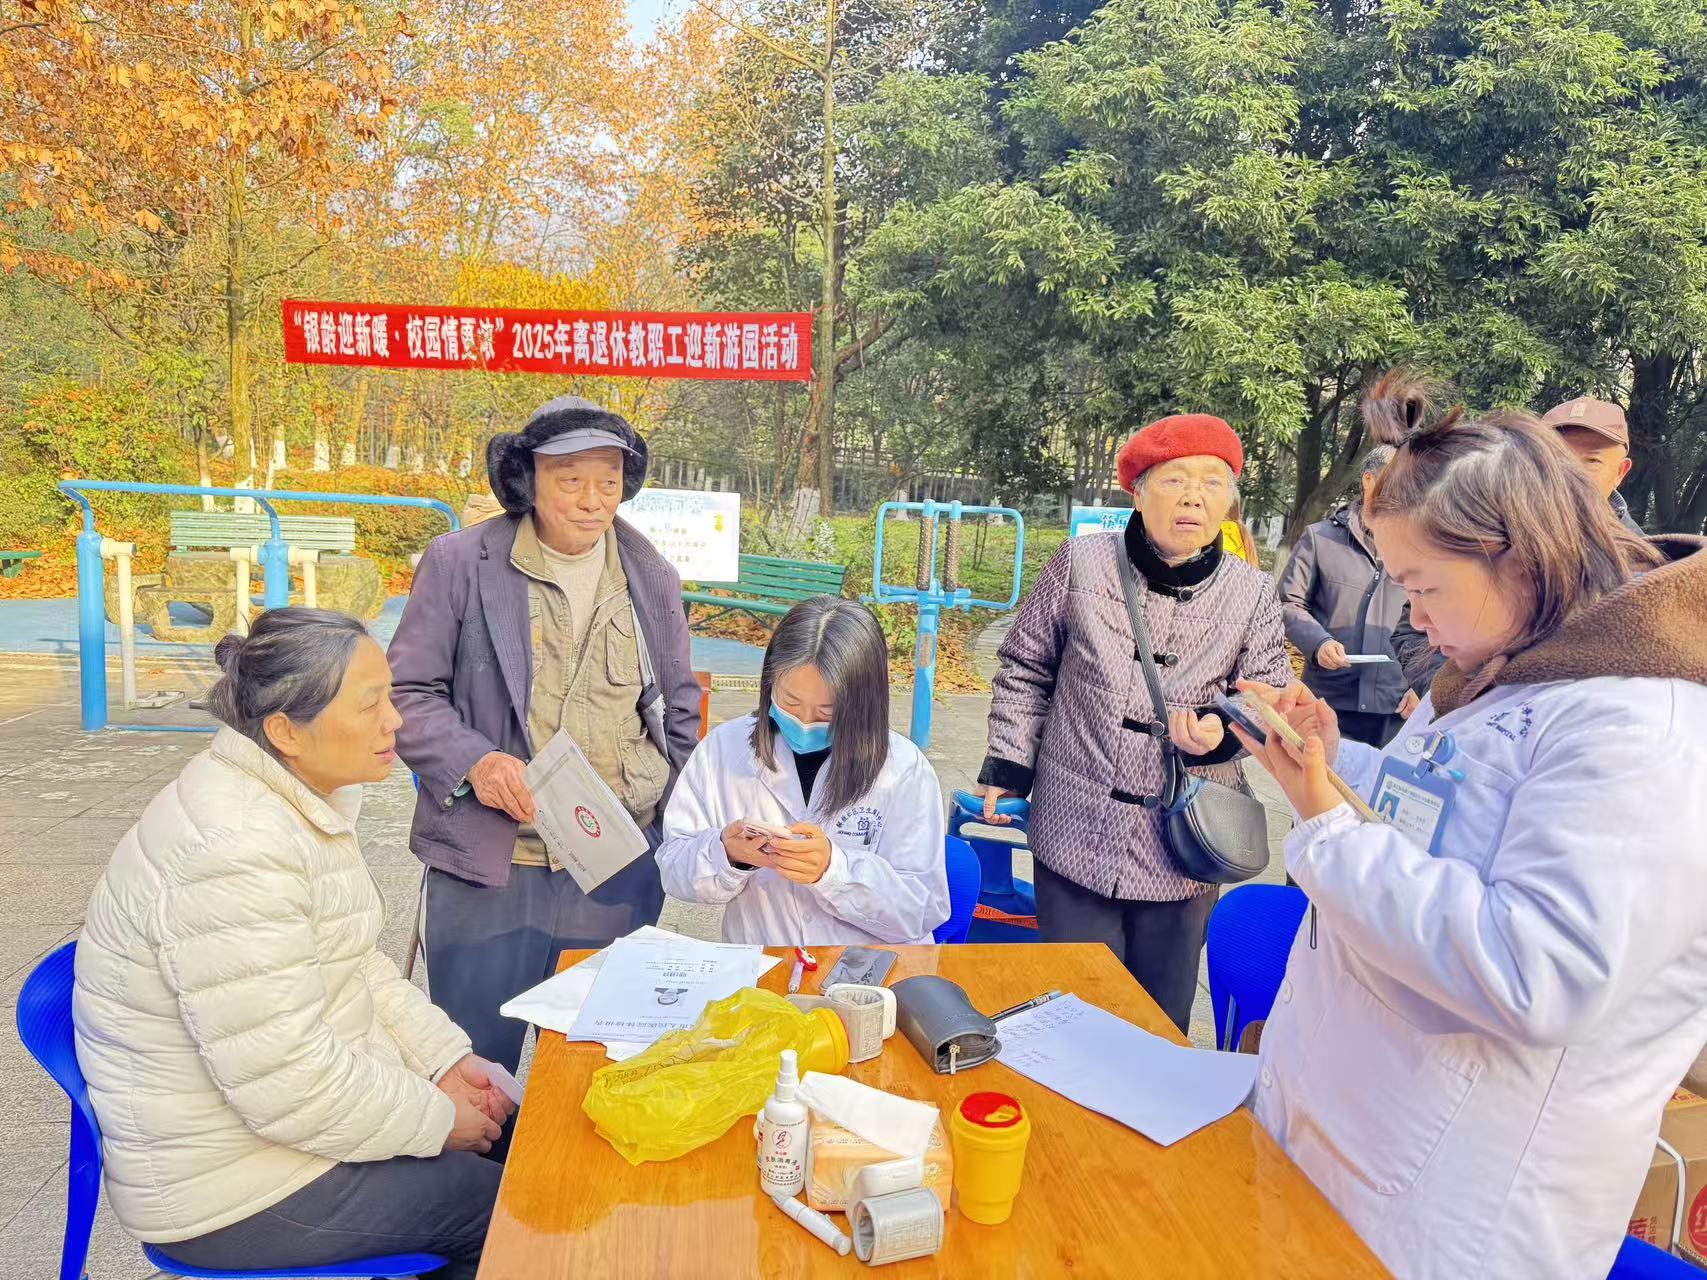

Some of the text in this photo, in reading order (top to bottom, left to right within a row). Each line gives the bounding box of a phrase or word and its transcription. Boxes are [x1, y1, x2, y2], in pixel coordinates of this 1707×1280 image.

[512, 319, 798, 370] 2025年离退休教职工迎新游园活动
